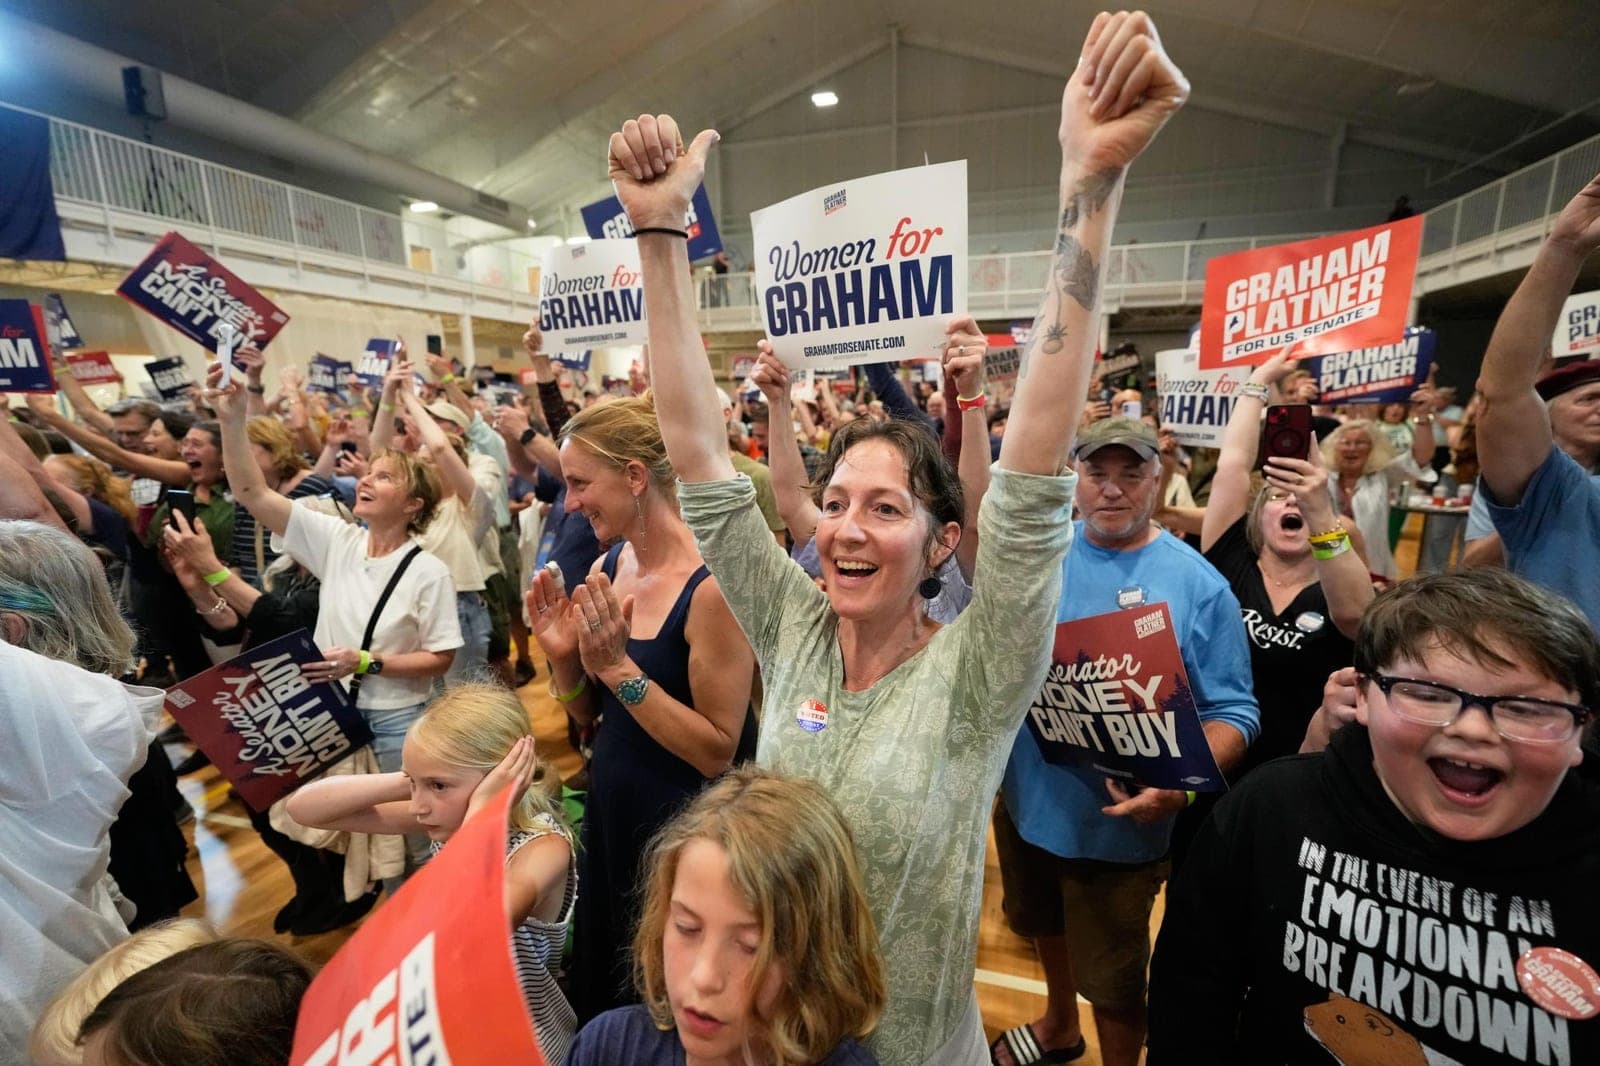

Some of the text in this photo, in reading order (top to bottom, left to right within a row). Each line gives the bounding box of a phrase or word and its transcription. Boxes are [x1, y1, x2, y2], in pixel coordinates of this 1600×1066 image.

[823, 188, 847, 204] GRAHAM
[769, 216, 943, 282] Women for
[1225, 229, 1392, 312] GRAHAM
[139, 271, 213, 326] CAN'T
[153, 260, 267, 338] MONEY
[543, 264, 642, 298] Women for
[765, 254, 953, 337] GRAHAM
[1223, 266, 1386, 345] PLATNER
[1235, 307, 1364, 355] FOR U.S. SENATE
[1568, 305, 1600, 325] GR
[803, 336, 905, 358] GRAHAMFORSENATE.COM
[1320, 357, 1417, 392] PLATNER
[1321, 336, 1419, 374] GRAHAM
[1213, 373, 1240, 394] for
[1134, 609, 1163, 627] GRAHAM
[1240, 608, 1305, 650] Resist.
[212, 691, 292, 777] A Senator
[222, 673, 321, 778] MONEY
[251, 652, 351, 762] CAN'T BUY
[1030, 706, 1182, 758] CAN'T BUY
[1298, 836, 1557, 938] IN THE EVENT OF AN
[1301, 874, 1533, 992] EMOTIONA
[1283, 920, 1571, 1066] BREAKDOWN
